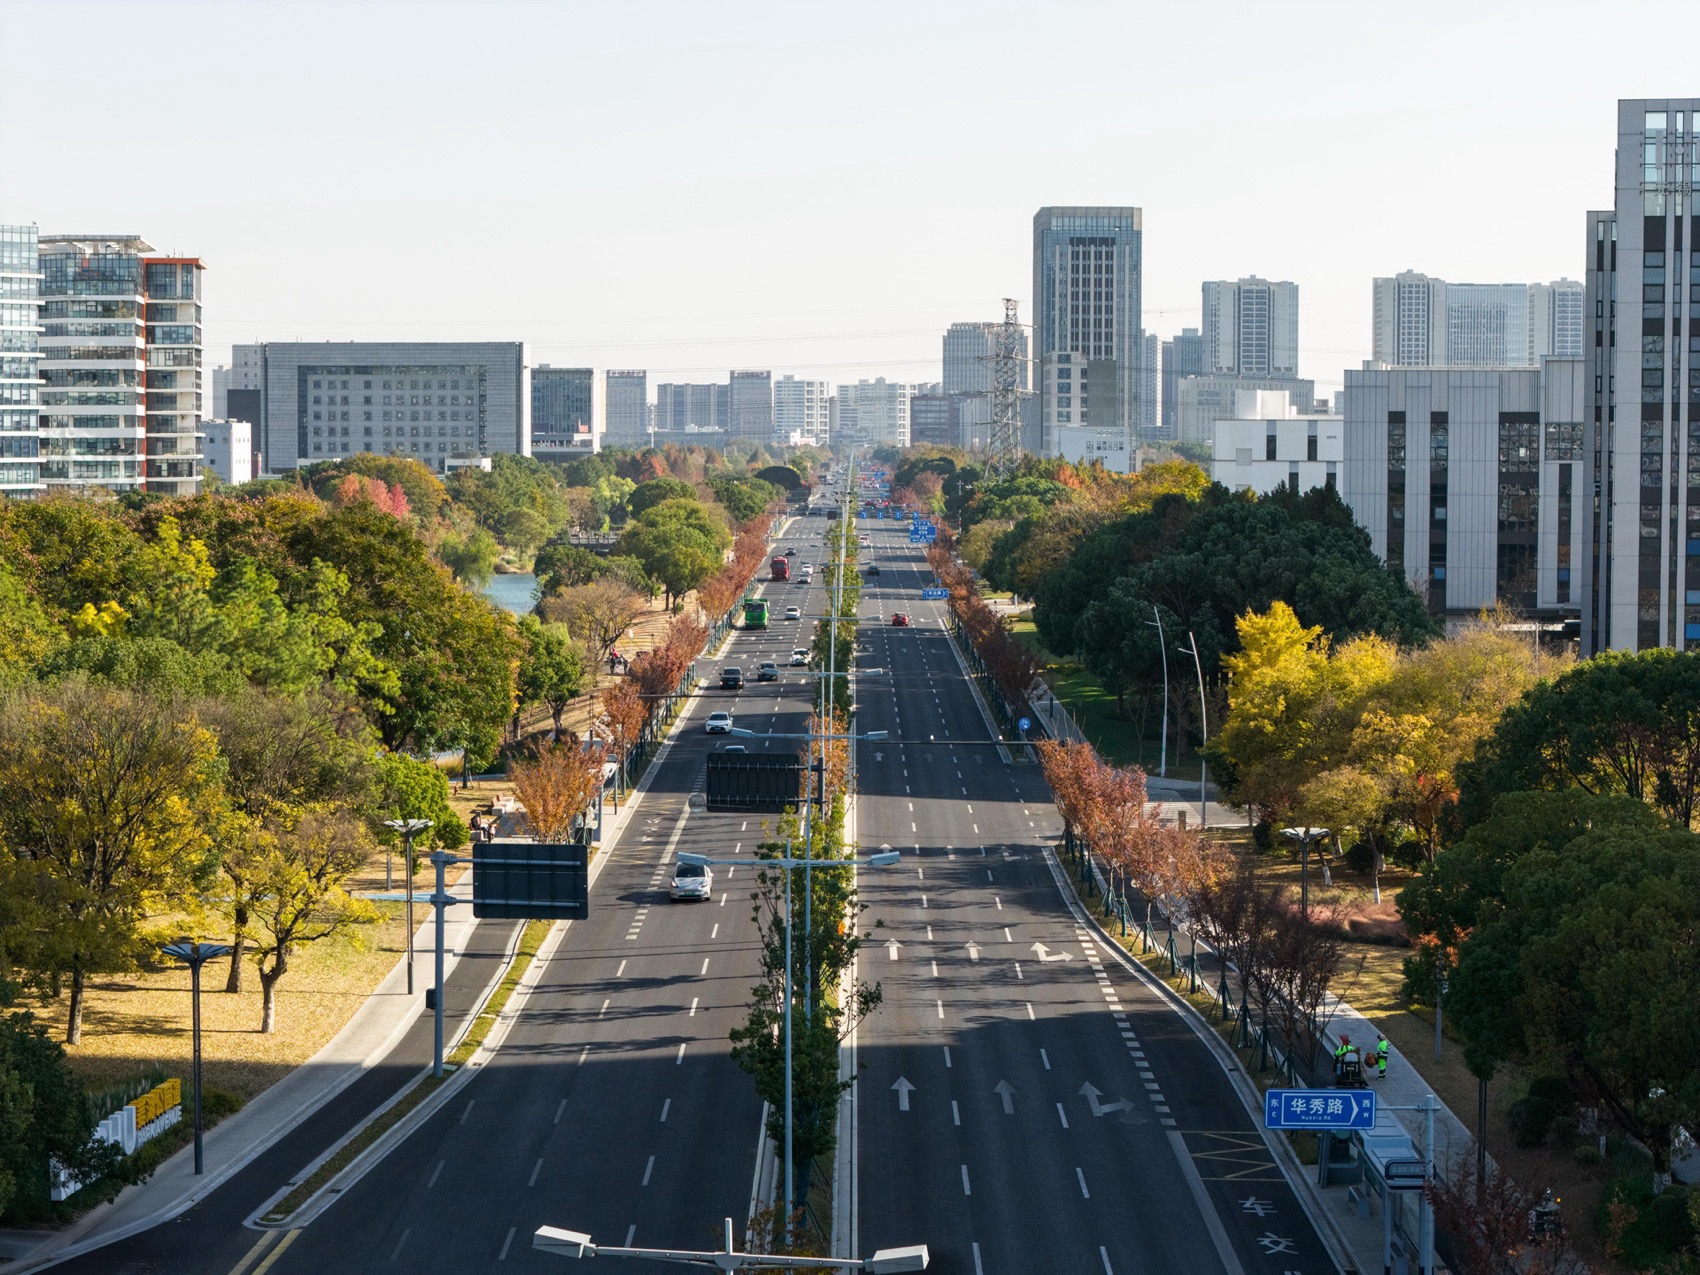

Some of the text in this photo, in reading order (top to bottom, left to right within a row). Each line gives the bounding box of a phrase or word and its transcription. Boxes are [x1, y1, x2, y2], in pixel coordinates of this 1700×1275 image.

[1270, 1098, 1279, 1108] 东
[1290, 1098, 1344, 1115] 华秀路
[1362, 1099, 1371, 1108] 西
[153, 1105, 183, 1136] AVENUE
